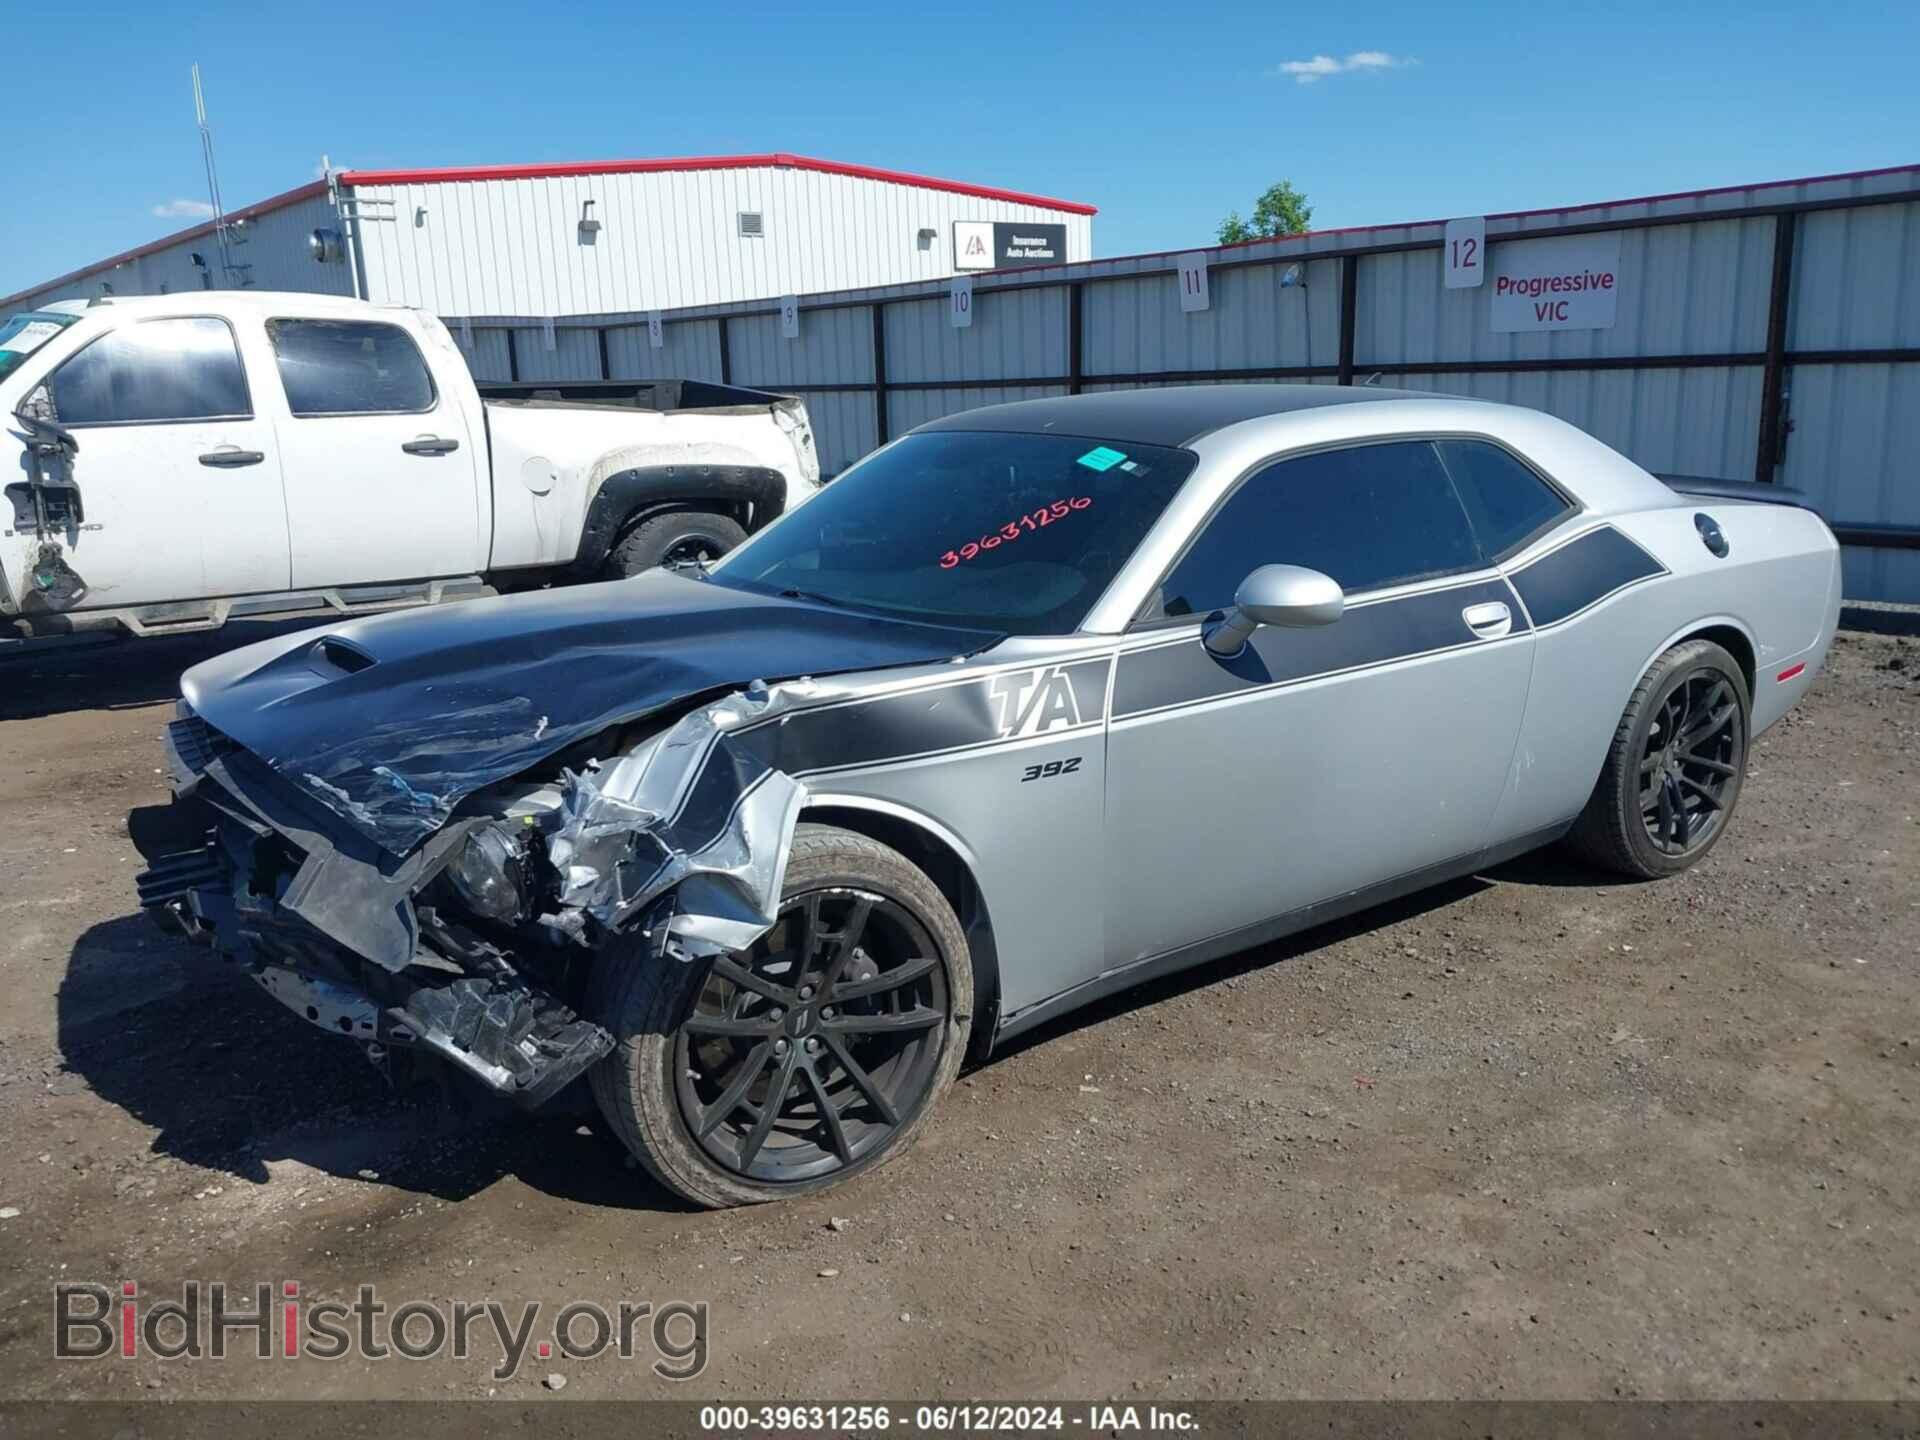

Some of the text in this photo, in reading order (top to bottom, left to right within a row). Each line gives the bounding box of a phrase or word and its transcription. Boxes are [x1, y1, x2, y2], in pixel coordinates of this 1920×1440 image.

[1452, 238, 1477, 269] 12
[1184, 269, 1201, 295] 11
[1496, 269, 1614, 297] Progressive
[954, 291, 968, 313] 10
[1534, 301, 1569, 322] VIC
[939, 496, 1092, 570] 39631256
[1021, 756, 1083, 783] 392
